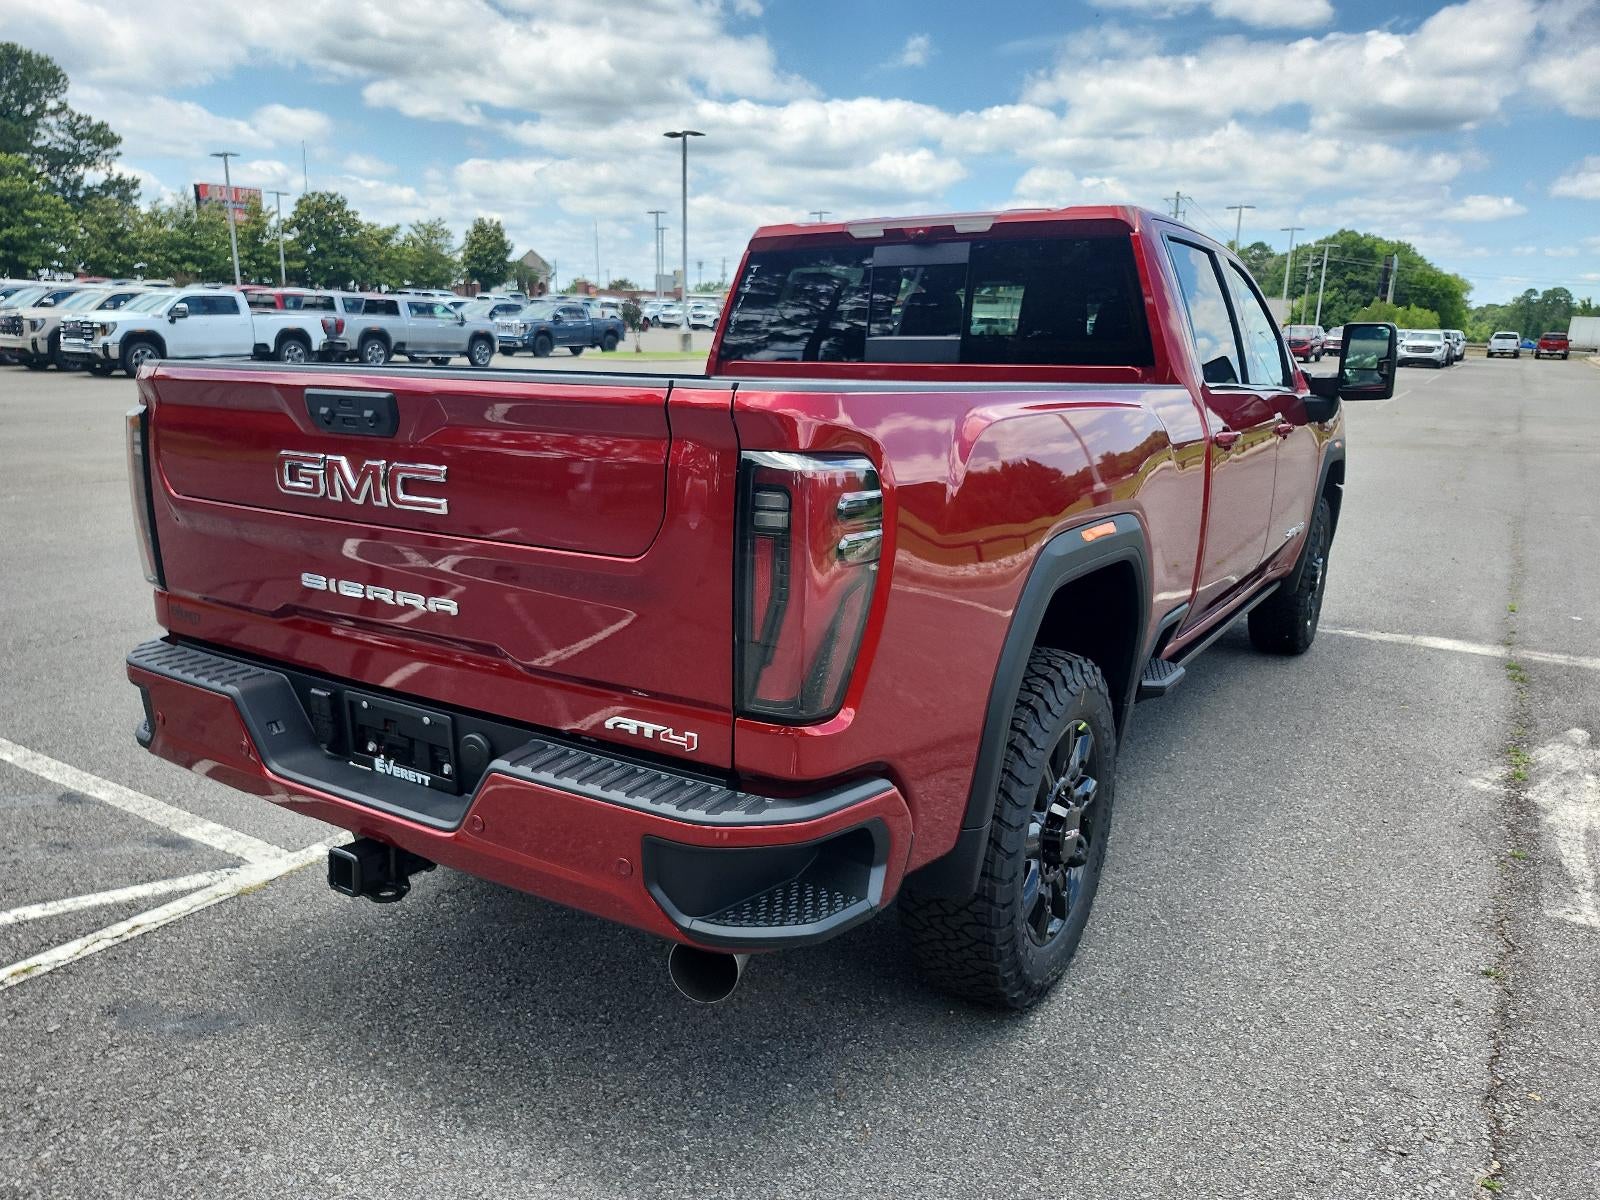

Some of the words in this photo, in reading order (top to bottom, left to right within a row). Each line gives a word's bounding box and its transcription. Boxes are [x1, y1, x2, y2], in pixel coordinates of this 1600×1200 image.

[276, 449, 449, 515] GMC
[301, 572, 459, 616] SIERRA
[604, 716, 698, 752] AT4
[374, 757, 431, 787] EVERETT
